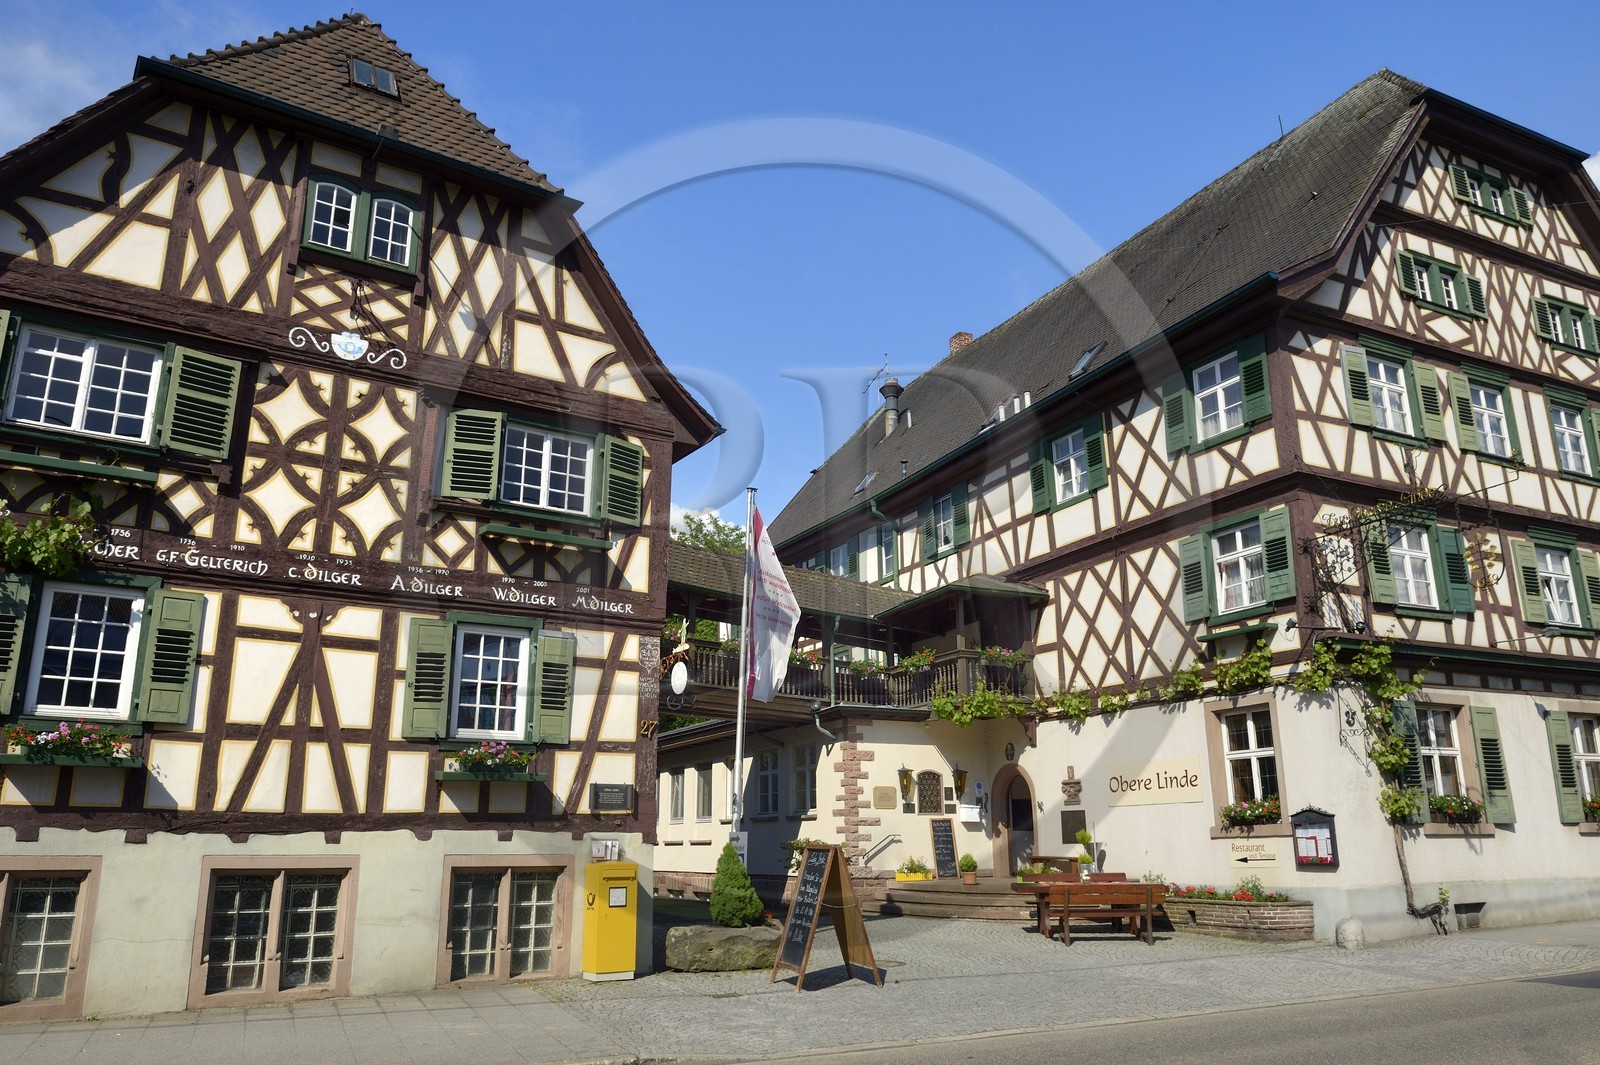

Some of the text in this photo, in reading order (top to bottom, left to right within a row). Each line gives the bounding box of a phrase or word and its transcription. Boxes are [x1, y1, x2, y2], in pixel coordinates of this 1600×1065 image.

[179, 537, 197, 546] 1736
[230, 544, 246, 552] 1910
[407, 565, 424, 574] 1936
[435, 568, 450, 576] 1970
[501, 576, 516, 584] 1970
[575, 586, 590, 594] 2001
[640, 719, 658, 739] 27
[1109, 769, 1198, 793] Obere Linde
[1231, 842, 1265, 852] Restaurant
